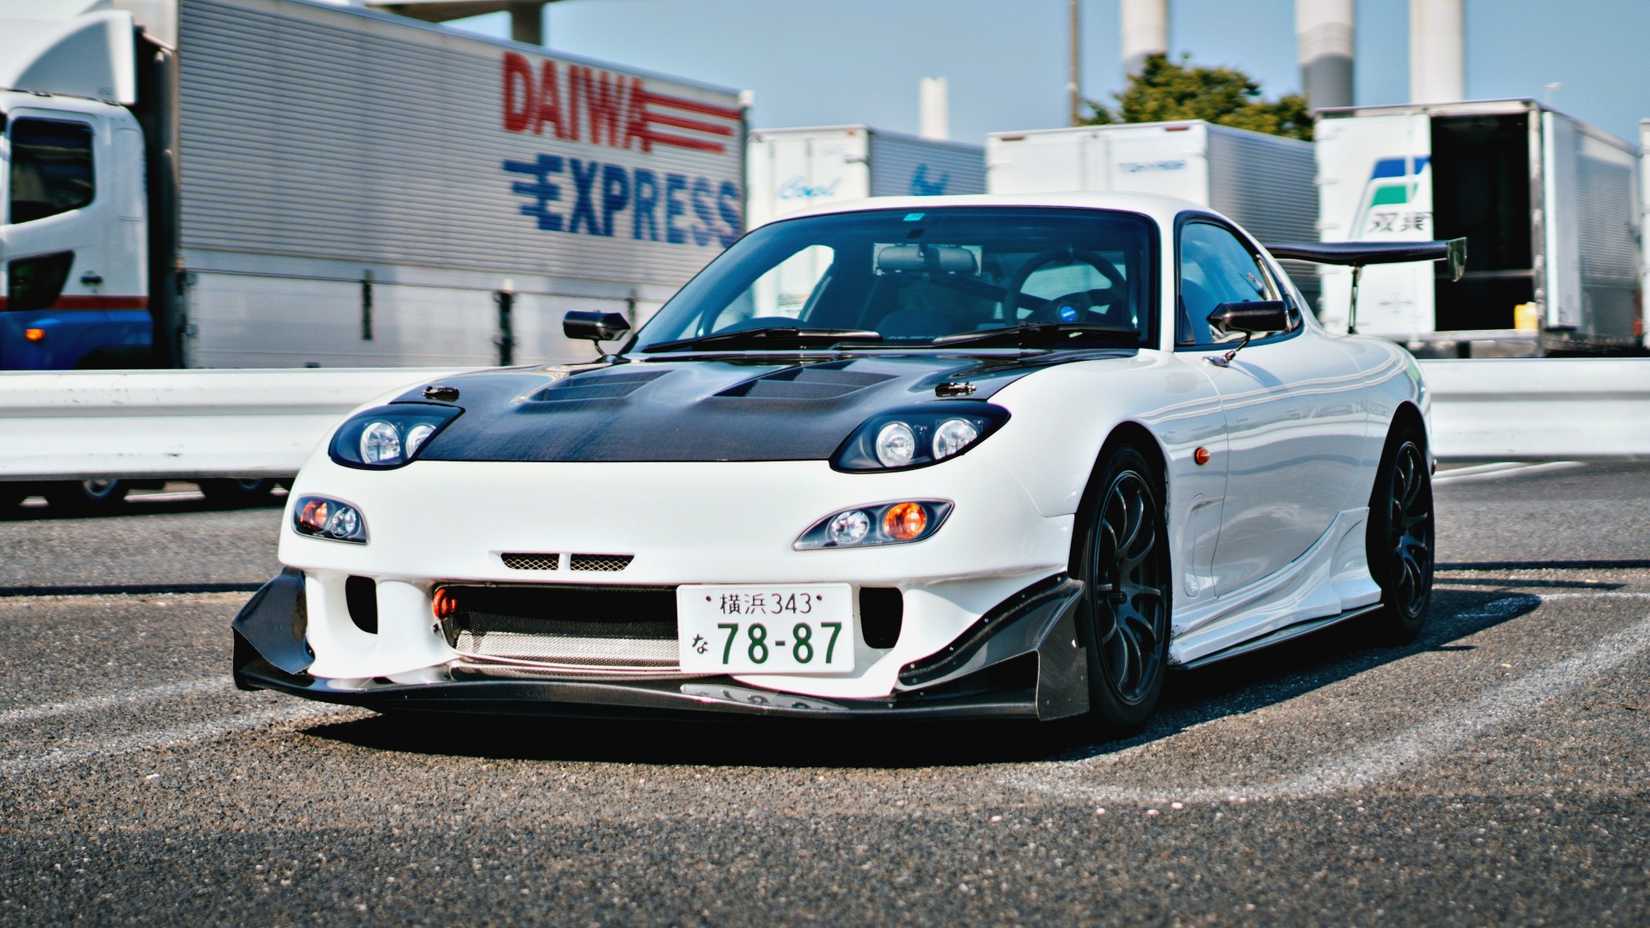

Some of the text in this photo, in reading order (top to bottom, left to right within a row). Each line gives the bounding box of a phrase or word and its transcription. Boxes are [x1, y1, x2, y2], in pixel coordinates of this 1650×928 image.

[502, 51, 654, 153] DAIWA
[502, 153, 739, 249] EXPRESS
[691, 621, 842, 665] な 78-87
